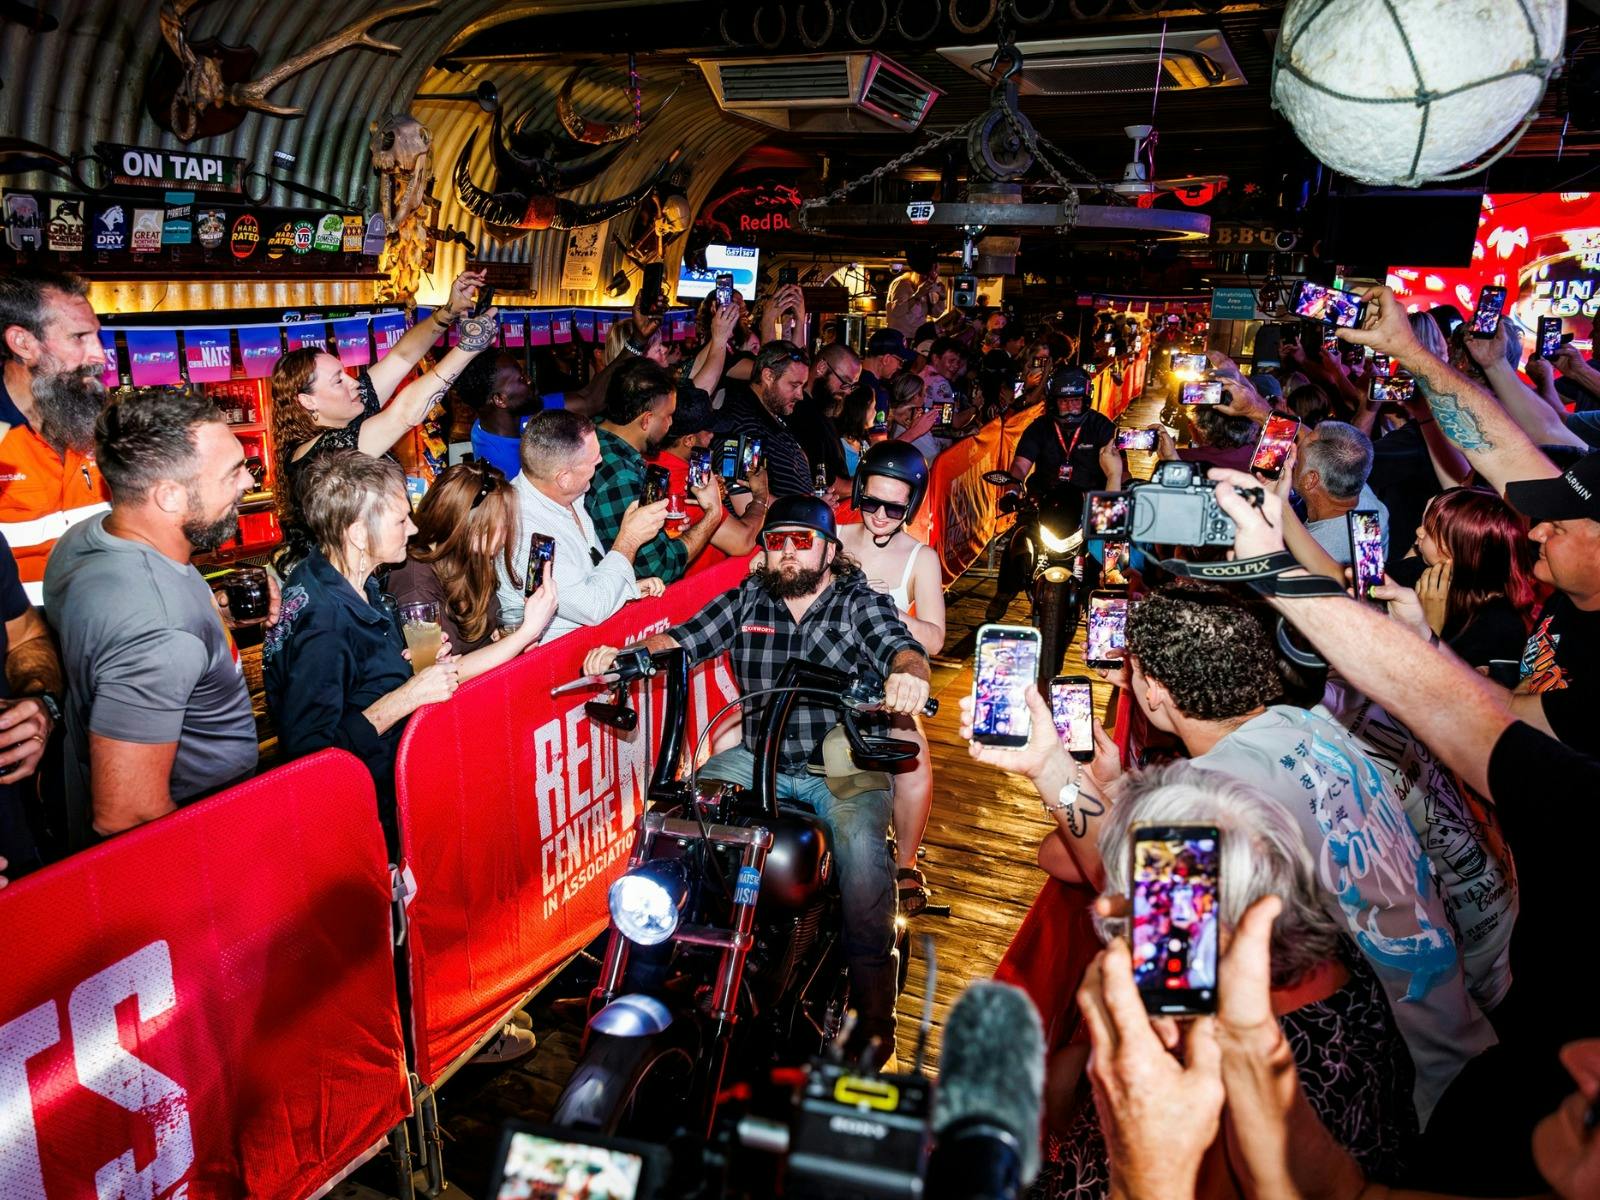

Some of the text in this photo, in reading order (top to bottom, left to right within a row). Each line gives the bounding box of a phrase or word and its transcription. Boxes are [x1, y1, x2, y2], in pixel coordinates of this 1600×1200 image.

[123, 152, 223, 182] ON TAP!
[911, 206, 930, 218] 216
[237, 225, 257, 233] HARD
[740, 213, 771, 231] Red
[97, 235, 124, 245] DRY
[134, 231, 160, 239] GREAT
[232, 233, 260, 242] RATED
[268, 238, 296, 246] RATED
[298, 234, 310, 243] VB
[201, 345, 231, 368] NATS
[1565, 470, 1592, 501] GARMIN
[1202, 559, 1271, 576] COOLPIX
[533, 690, 615, 841] RED
[541, 791, 617, 897] CENTRE
[543, 829, 637, 920] IN ASSOCIATIO
[829, 1115, 889, 1140] SONY
